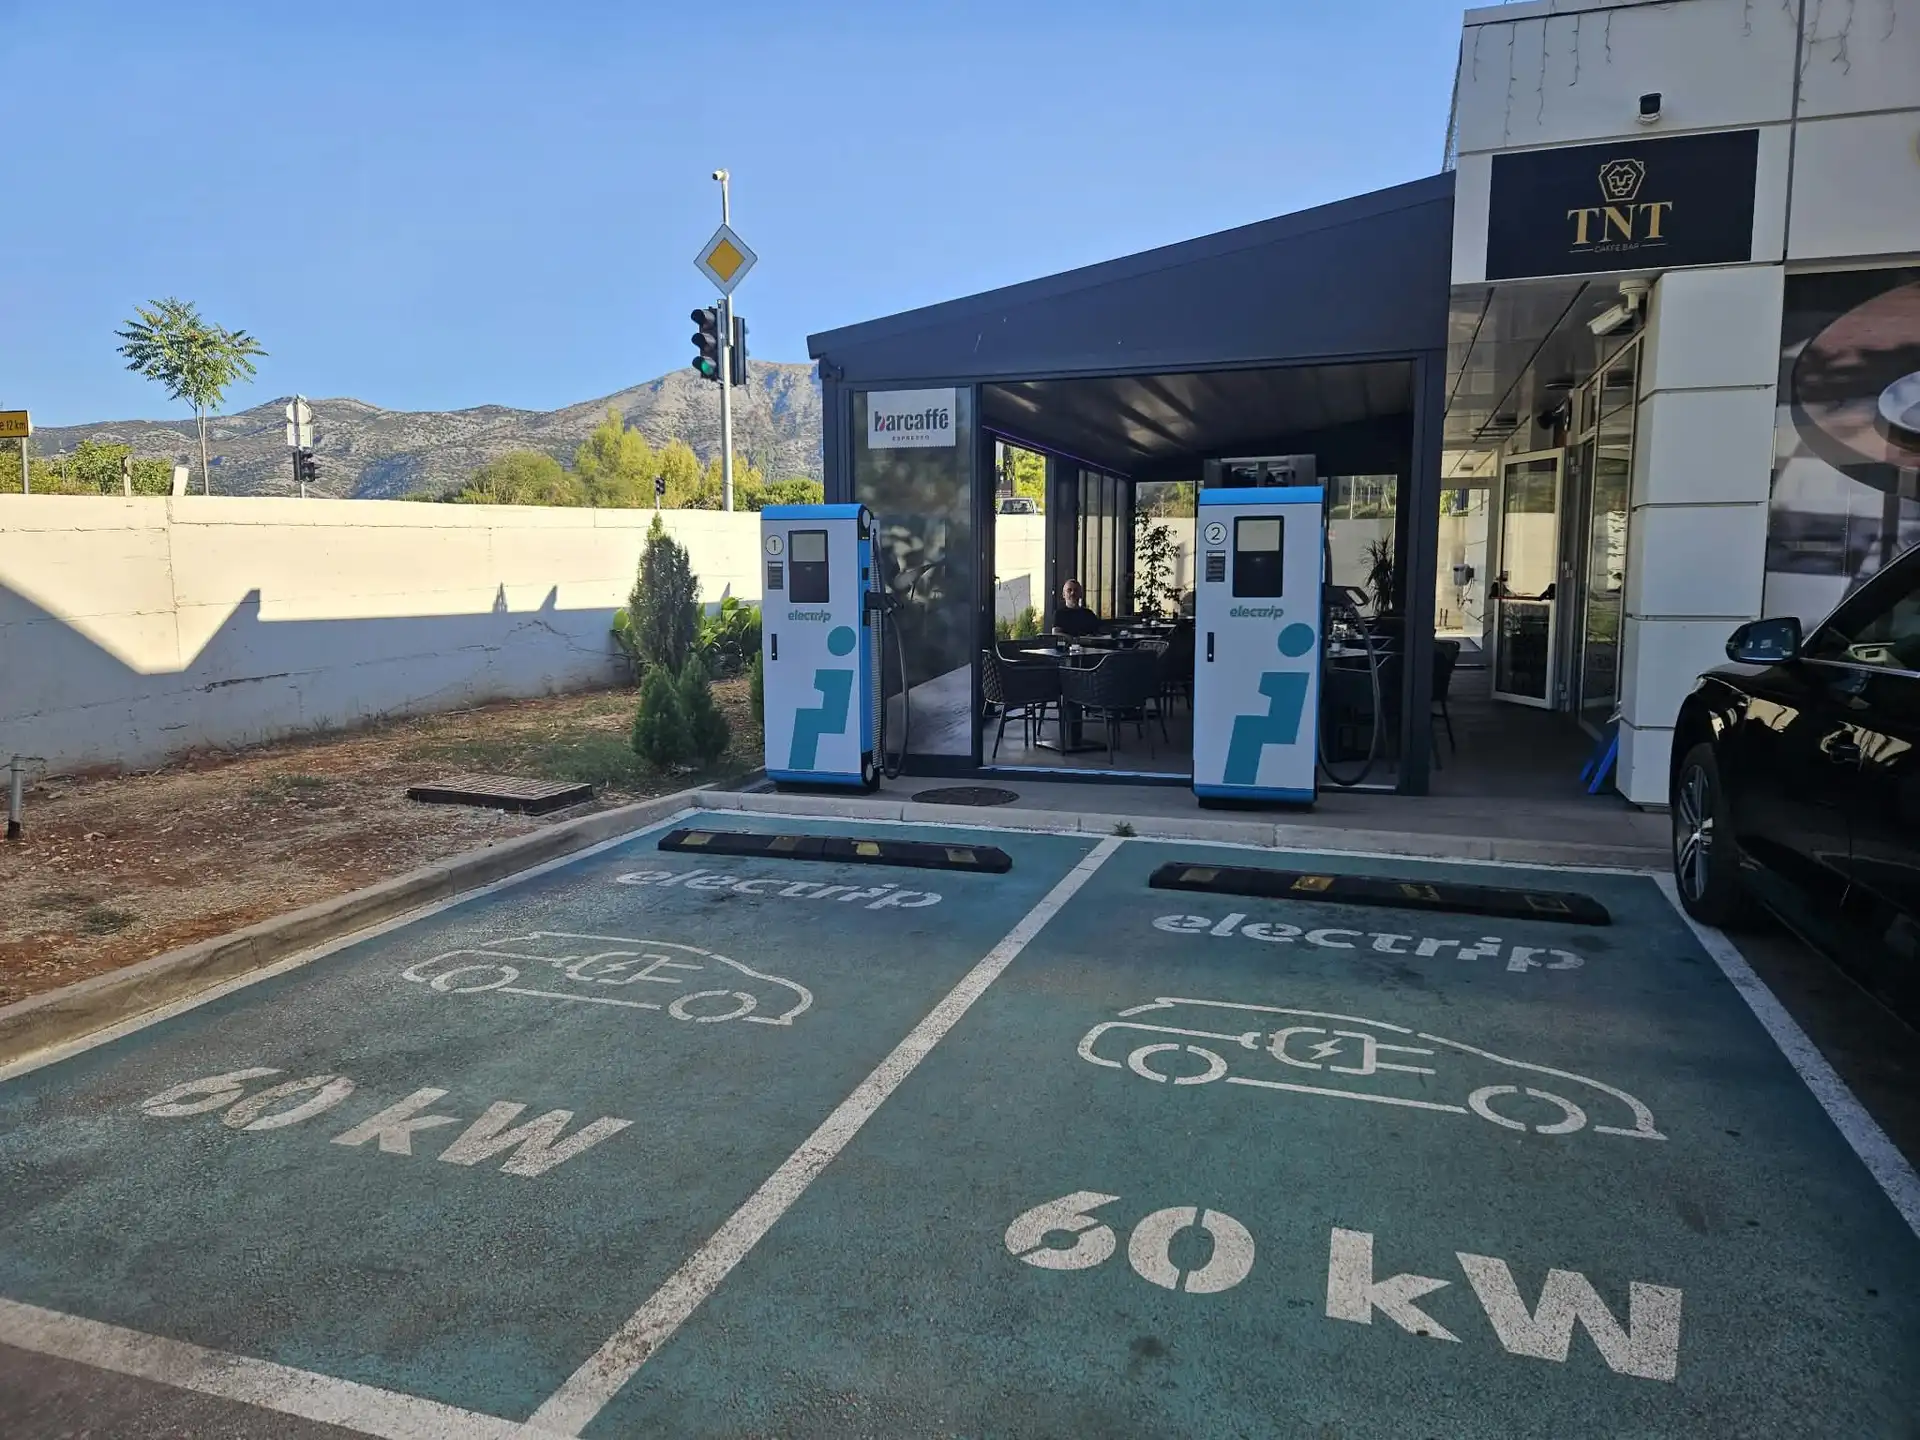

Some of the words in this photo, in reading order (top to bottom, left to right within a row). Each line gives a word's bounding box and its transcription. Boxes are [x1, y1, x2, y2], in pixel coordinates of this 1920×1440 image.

[1567, 201, 1673, 245] TNT
[6, 420, 13, 431] 12
[15, 420, 26, 431] km
[874, 408, 949, 432] barcaffé
[1211, 526, 1221, 541] 2
[788, 609, 832, 623] electrip
[1230, 605, 1284, 620] electrip
[616, 868, 943, 910] electrip
[1152, 913, 1585, 973] electrip
[140, 1067, 356, 1131] 60
[329, 1086, 635, 1178] kW
[1004, 1190, 1256, 1294] 60
[1325, 1226, 1683, 1383] kW
